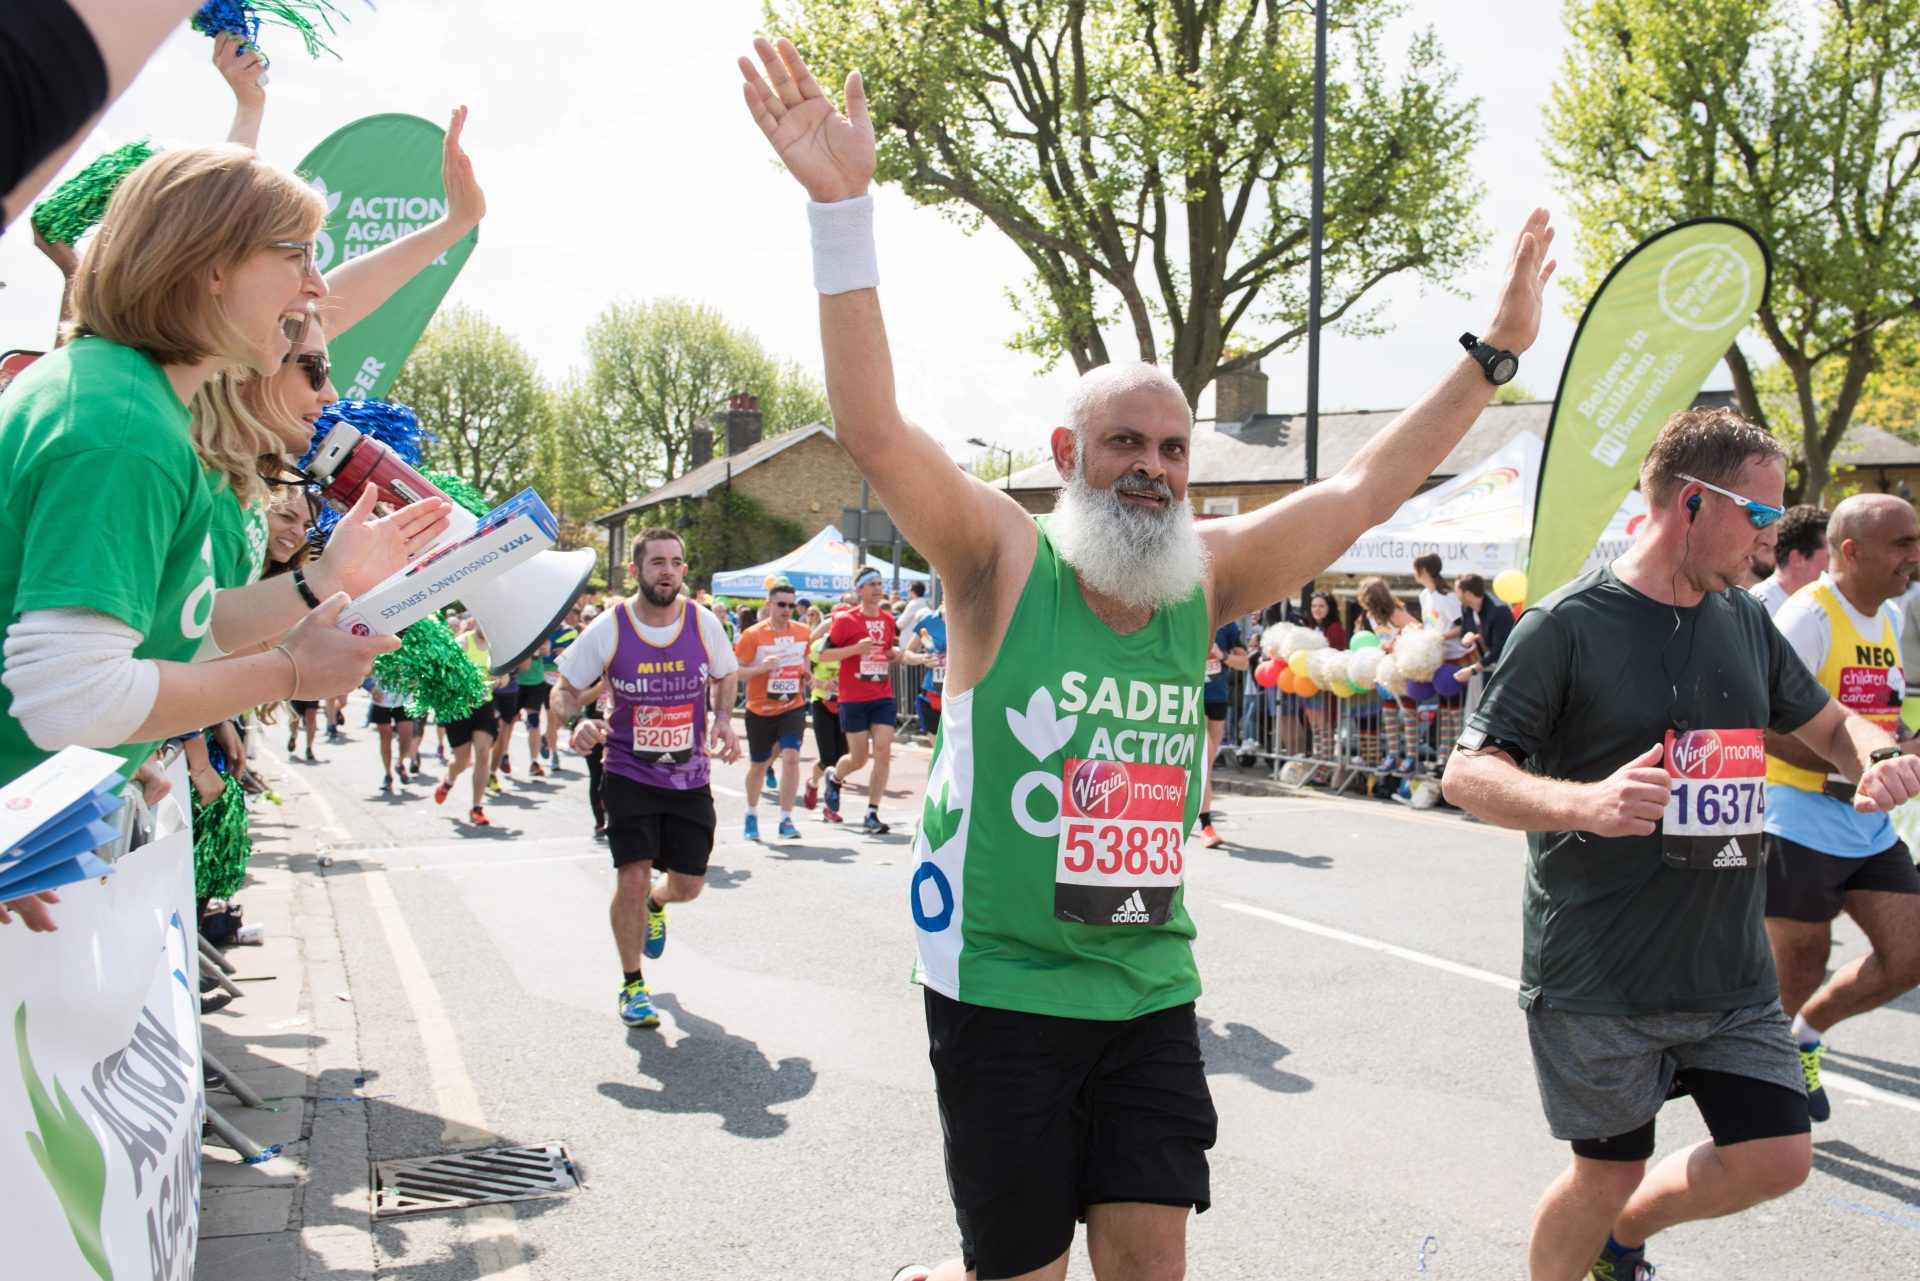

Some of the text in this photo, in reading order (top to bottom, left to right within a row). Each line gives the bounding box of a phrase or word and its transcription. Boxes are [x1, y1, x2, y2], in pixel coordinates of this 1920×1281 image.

[346, 196, 449, 219] ACTION
[1625, 328, 1649, 351] in
[1597, 352, 1656, 429] children
[380, 533, 533, 620] TATA CONSULTANCY SERVICES
[804, 575, 829, 589] tel:
[637, 660, 685, 674] MIKE
[1855, 644, 1895, 668] NEO
[612, 675, 699, 693] WellChild
[771, 681, 796, 690] 6625
[1842, 669, 1886, 686] children
[1058, 671, 1201, 725] SADEK
[1841, 693, 1875, 703] cancer
[664, 712, 691, 720] money
[637, 726, 691, 748] 52057
[1087, 727, 1197, 764] ACTION
[1675, 732, 1719, 775] Virgin
[1075, 762, 1126, 813] Virgin
[1134, 781, 1182, 806] money
[1671, 782, 1765, 825] 16374
[1064, 824, 1183, 875] 53833
[1713, 856, 1747, 867] adidas
[1111, 911, 1150, 923] adidas
